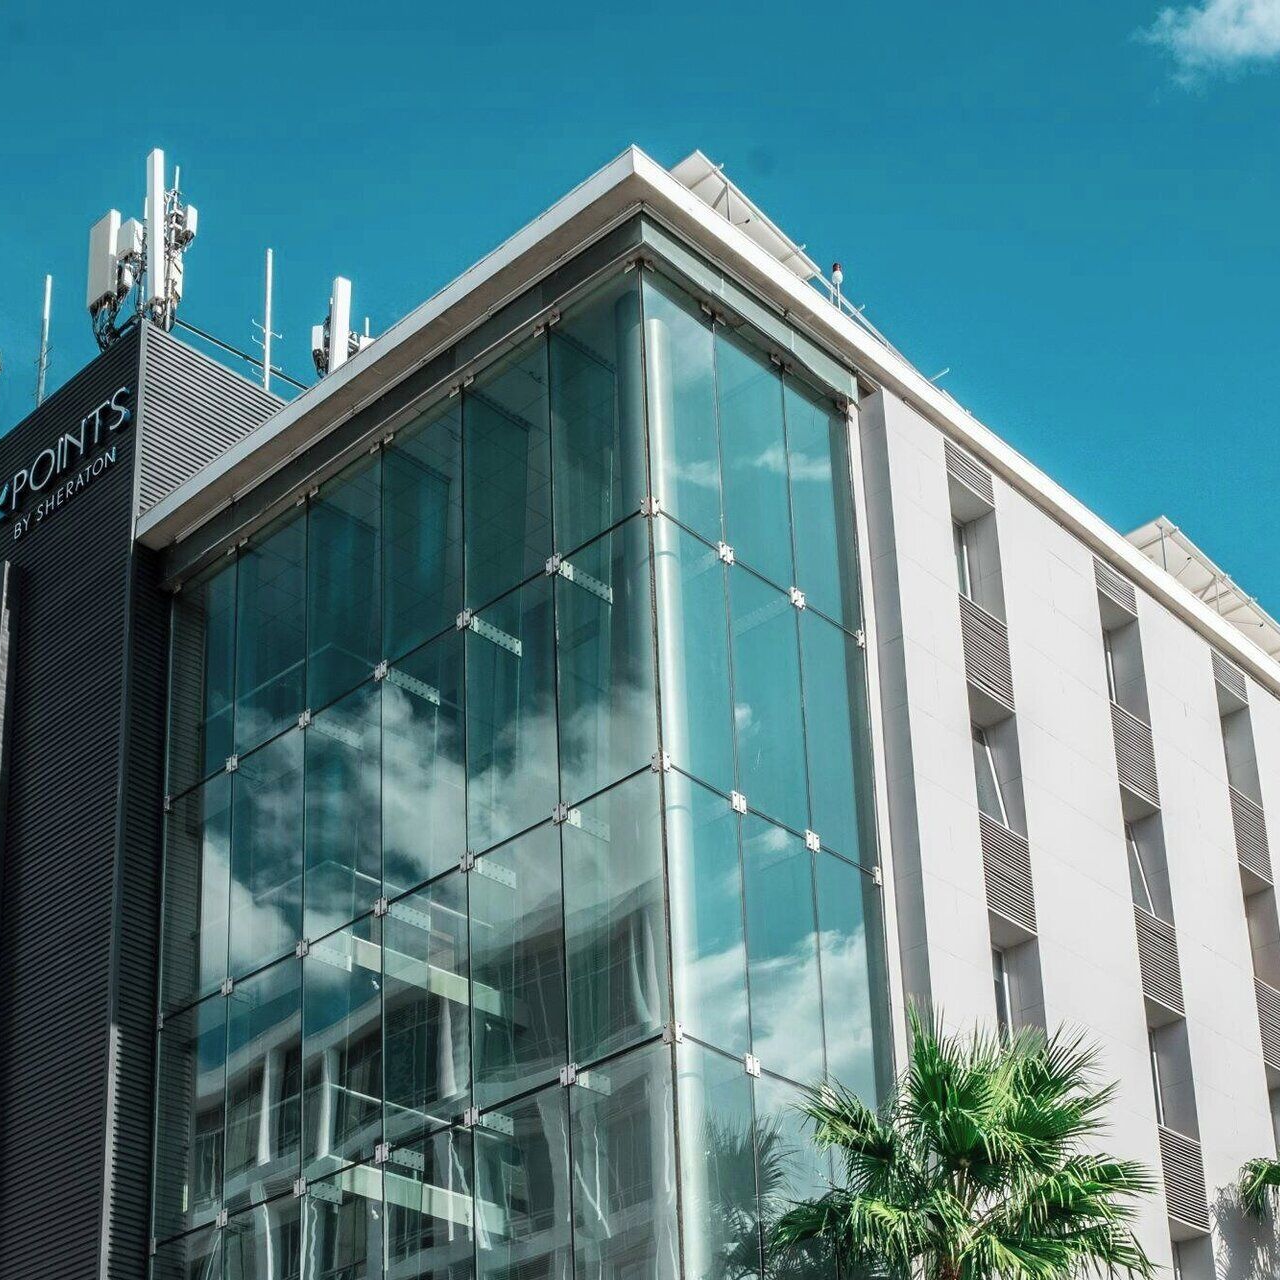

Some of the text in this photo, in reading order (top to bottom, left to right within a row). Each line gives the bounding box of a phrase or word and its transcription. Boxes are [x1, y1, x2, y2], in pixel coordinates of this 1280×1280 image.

[11, 386, 131, 510] POINTS
[13, 446, 116, 540] BY SHERATON
